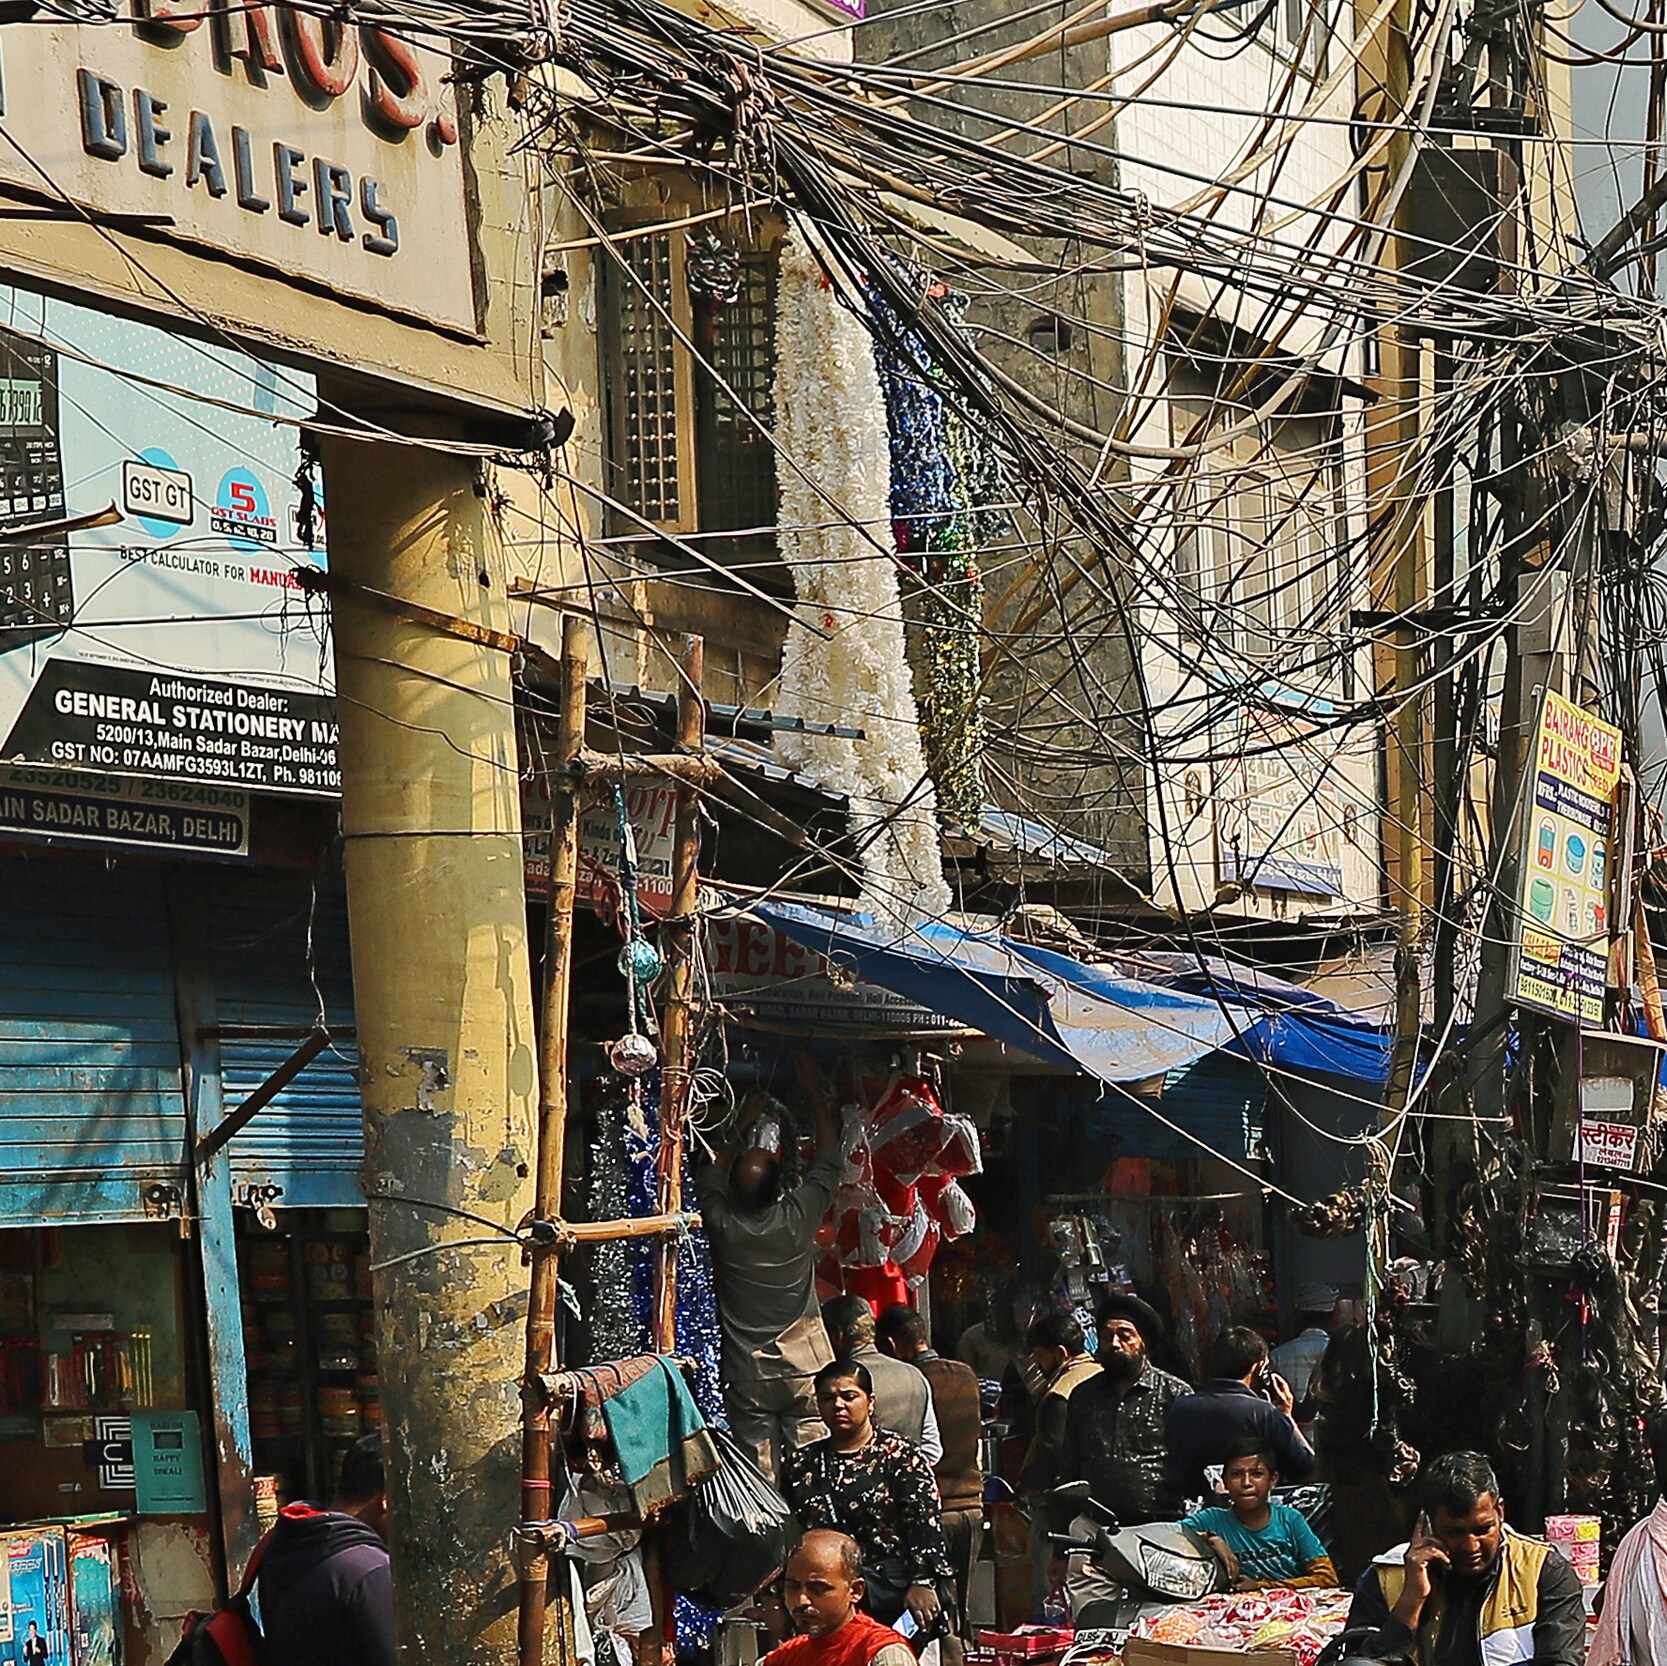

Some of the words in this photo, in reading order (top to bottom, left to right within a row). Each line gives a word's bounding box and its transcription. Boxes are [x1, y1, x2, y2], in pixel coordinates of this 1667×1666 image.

[76, 68, 400, 257] DEALERS
[130, 477, 162, 504] GST
[166, 484, 186, 509] GT
[151, 552, 220, 577] CALCULATOR
[225, 564, 245, 582] FOR
[150, 677, 233, 708] Authorized
[237, 689, 289, 714] Dealer:
[55, 690, 166, 726] GENERAL
[173, 706, 306, 742] STATIONERY
[51, 741, 86, 762] GST
[196, 735, 237, 757] Sadar
[33, 799, 100, 828] SADAR
[107, 808, 177, 839] BAZAR,
[183, 817, 238, 843] DELHI
